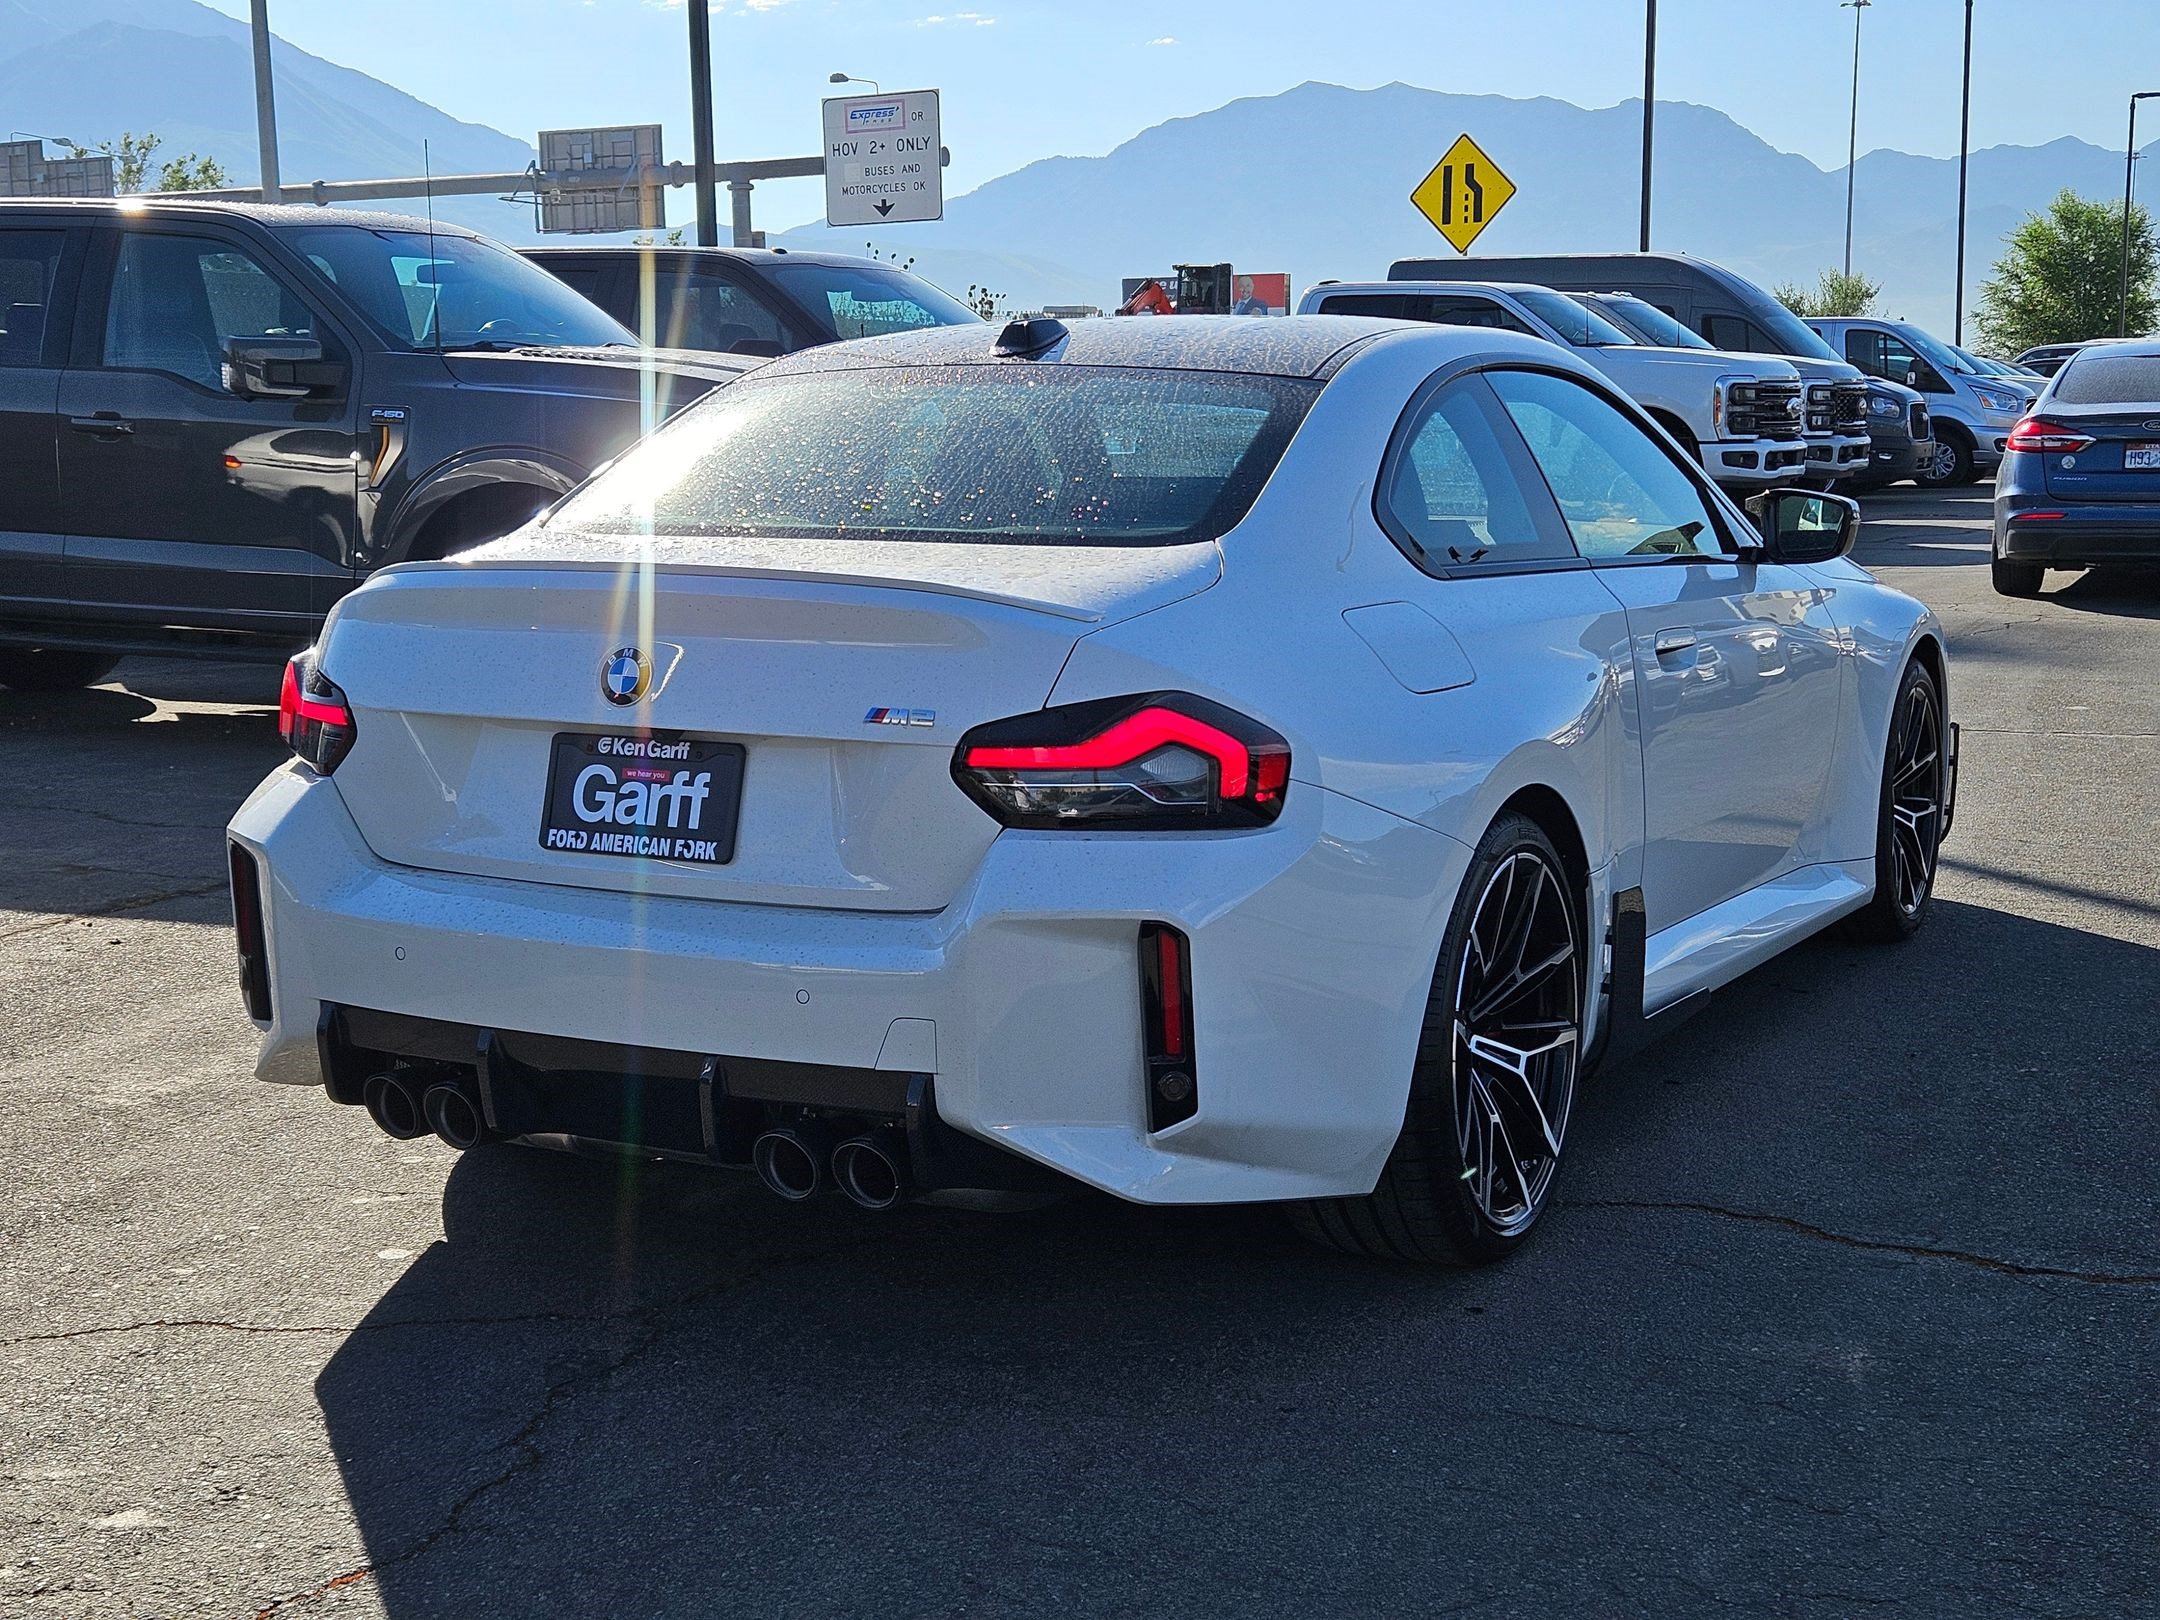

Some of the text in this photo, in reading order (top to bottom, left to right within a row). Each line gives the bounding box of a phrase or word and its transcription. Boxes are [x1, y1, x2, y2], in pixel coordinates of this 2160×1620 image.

[850, 106, 924, 125] Express OR
[832, 136, 931, 157] HOV 2+ ONLY
[864, 164, 921, 177] BUSES AND
[842, 181, 926, 196] MOTORCYCLES OK
[371, 410, 405, 418] F-150
[607, 648, 649, 668] BMW
[880, 708, 936, 727] M2
[612, 738, 690, 760] Ken Garff
[637, 770, 652, 778] hear
[652, 772, 666, 780] you
[573, 763, 712, 831] Garff
[547, 828, 718, 861] FORD AMERICAN FORK
